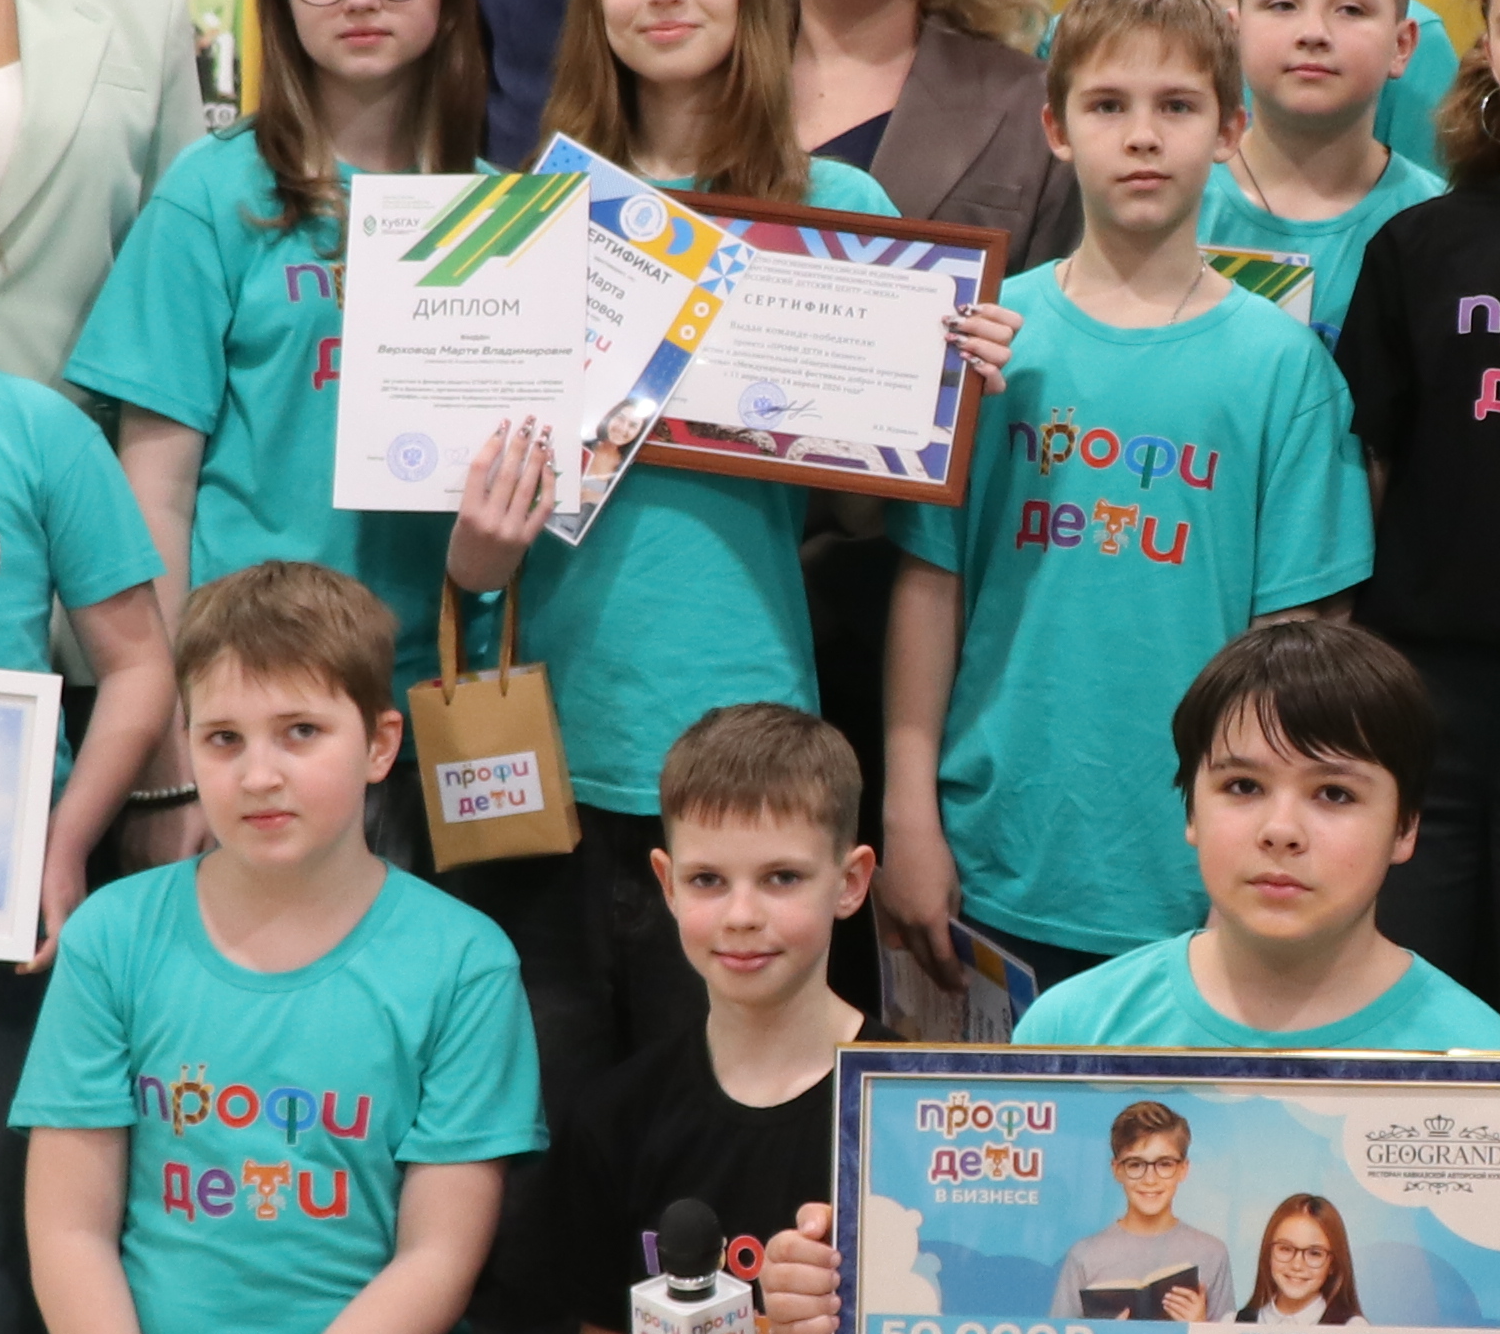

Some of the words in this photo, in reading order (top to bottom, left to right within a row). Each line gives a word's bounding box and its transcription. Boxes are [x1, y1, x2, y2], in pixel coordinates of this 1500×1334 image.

[588, 228, 672, 285] ЕРТИФИКАТ
[412, 298, 520, 320] ДИПЛОМ
[743, 293, 869, 320] СЕРТИФИКАТ
[377, 345, 436, 357] Верховод
[439, 345, 479, 358] Марте
[935, 1189, 947, 1203] В
[952, 1189, 1039, 1205] БИЗНЕСЕ
